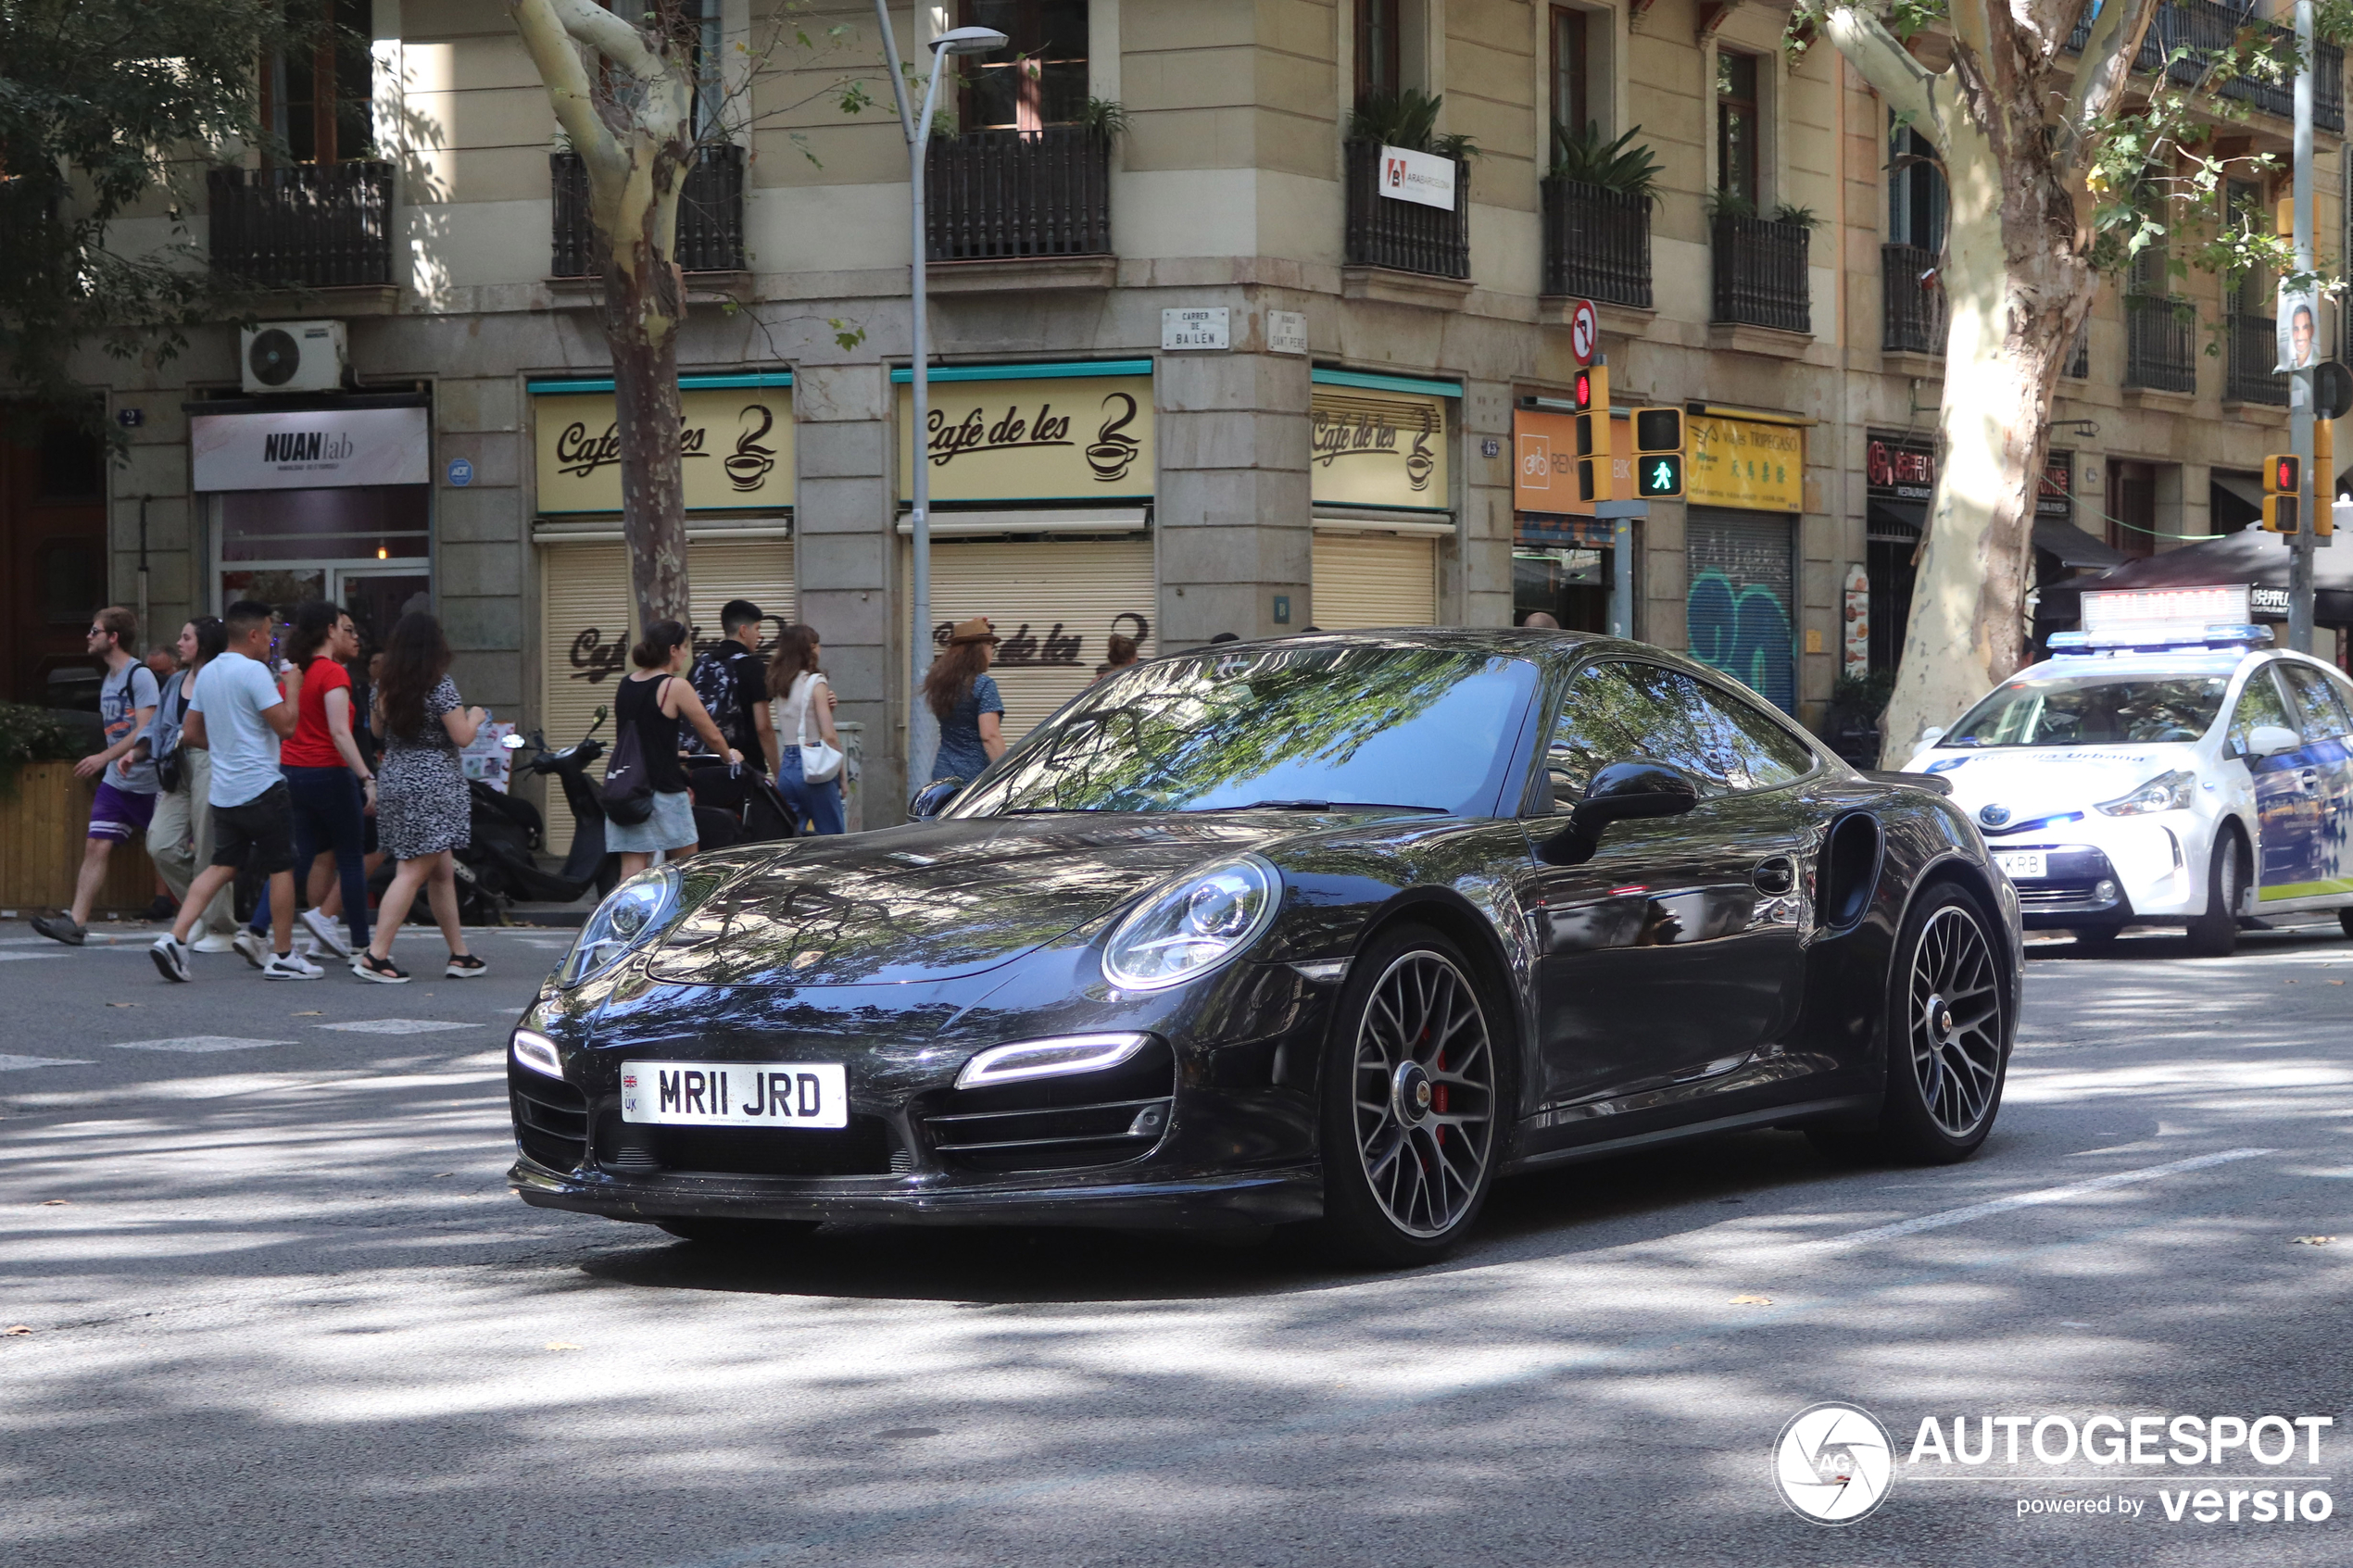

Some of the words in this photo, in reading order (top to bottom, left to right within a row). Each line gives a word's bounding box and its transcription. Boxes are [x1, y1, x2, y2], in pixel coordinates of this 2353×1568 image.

[1182, 312, 1209, 321] CARRER
[1273, 335, 1288, 346] SANT
[1290, 337, 1304, 348] PERE
[127, 409, 135, 424] 2
[988, 406, 1026, 444] de
[1031, 404, 1071, 441] les
[1353, 413, 1374, 448] de
[1376, 413, 1396, 448] les
[1750, 431, 1797, 452] TRIPEGASO
[451, 466, 469, 476] ADT
[1613, 458, 1632, 480] BIK
[570, 628, 627, 684] Caf
[2066, 752, 2145, 763] Urbana
[659, 1070, 728, 1115] MR11
[742, 1072, 821, 1117] JRD
[625, 1098, 637, 1110] UK
